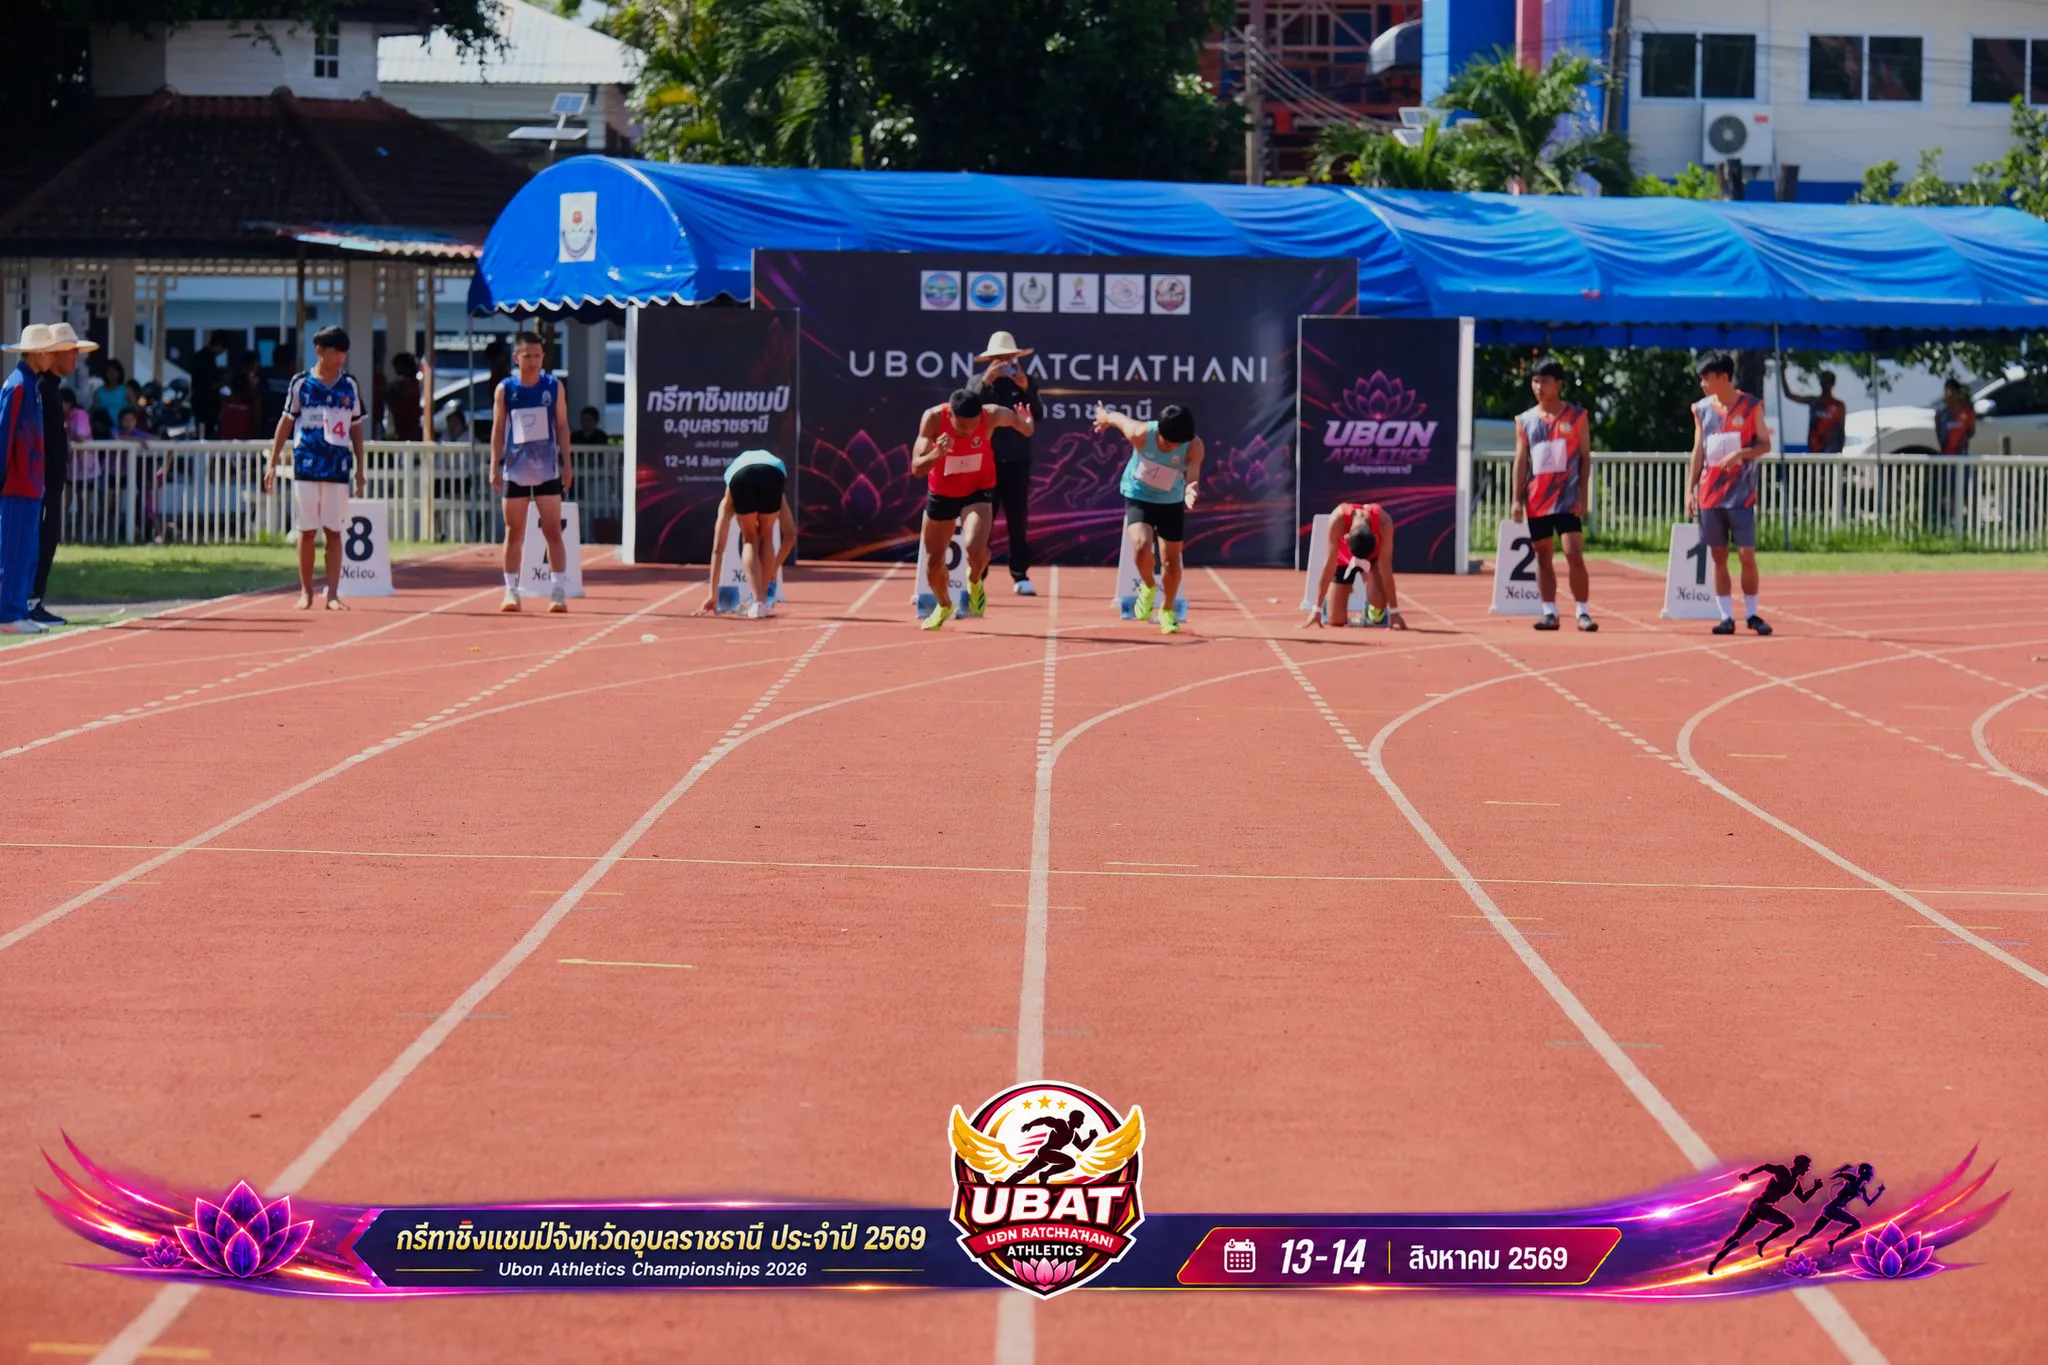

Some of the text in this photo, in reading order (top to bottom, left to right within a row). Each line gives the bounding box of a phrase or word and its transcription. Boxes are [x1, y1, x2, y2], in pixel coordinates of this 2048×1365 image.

[849, 350, 1268, 383] UBON ATCHATHANI
[1323, 420, 1439, 447] UBON
[345, 515, 374, 562] 8
[1510, 537, 1536, 581] 2
[1686, 541, 1707, 585] 1
